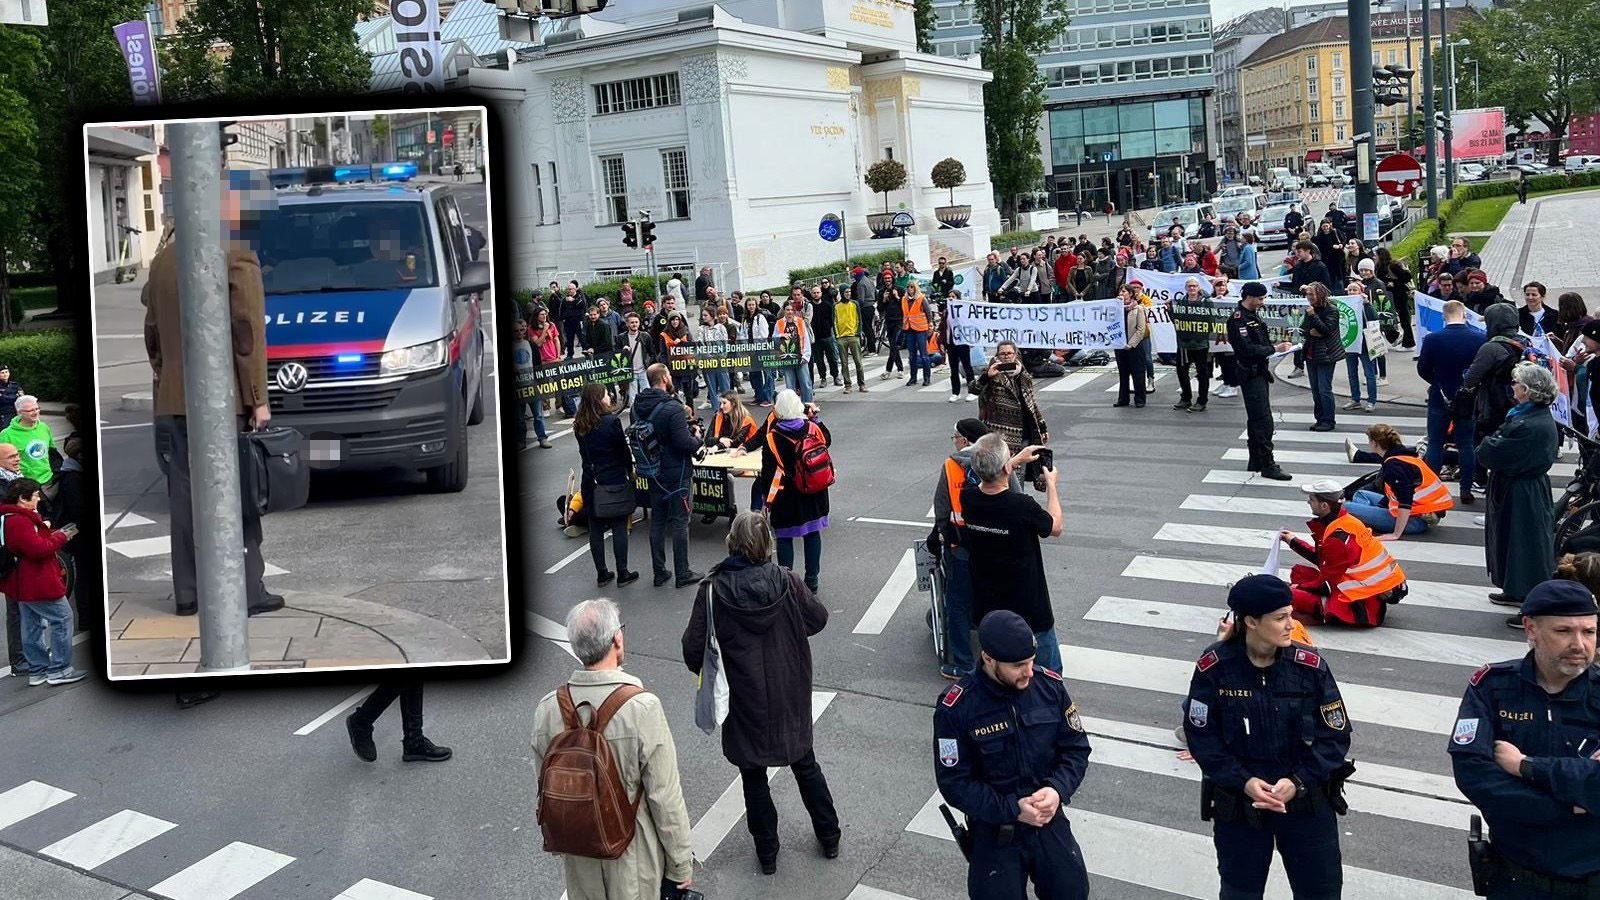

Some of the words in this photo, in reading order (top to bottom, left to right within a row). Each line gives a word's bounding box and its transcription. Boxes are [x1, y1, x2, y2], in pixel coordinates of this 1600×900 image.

[1143, 287, 1169, 301] MAS
[265, 311, 365, 326] LIZEI
[950, 304, 963, 319] IT
[968, 303, 1024, 320] AFFECTS
[1027, 306, 1049, 322] US
[1054, 306, 1086, 322] ALL!
[1091, 305, 1117, 322] THE
[1173, 304, 1186, 314] WIR
[1187, 305, 1210, 316] RASEN
[1211, 307, 1219, 316] IN
[1219, 308, 1231, 317] DIE
[1174, 318, 1209, 333] RUNTER
[670, 346, 694, 356] KEINE
[696, 344, 724, 355] NEUEN
[726, 340, 775, 353] BOHRUNGEN!
[515, 372, 535, 382] ASEN
[535, 369, 544, 379] IN
[545, 367, 557, 378] DIE
[559, 358, 607, 376] KLIMAHÖLLE.
[671, 359, 686, 371] 100
[698, 358, 718, 369] SIND
[720, 355, 751, 368] GENUG!
[515, 386, 535, 399] TER
[537, 380, 559, 395] VOM
[560, 376, 584, 390] GAS!
[692, 468, 723, 481] AHÖLLE.
[700, 481, 724, 498] GAS!
[1499, 709, 1534, 721] OLIZEI
[974, 721, 1009, 737] POLIZEI
